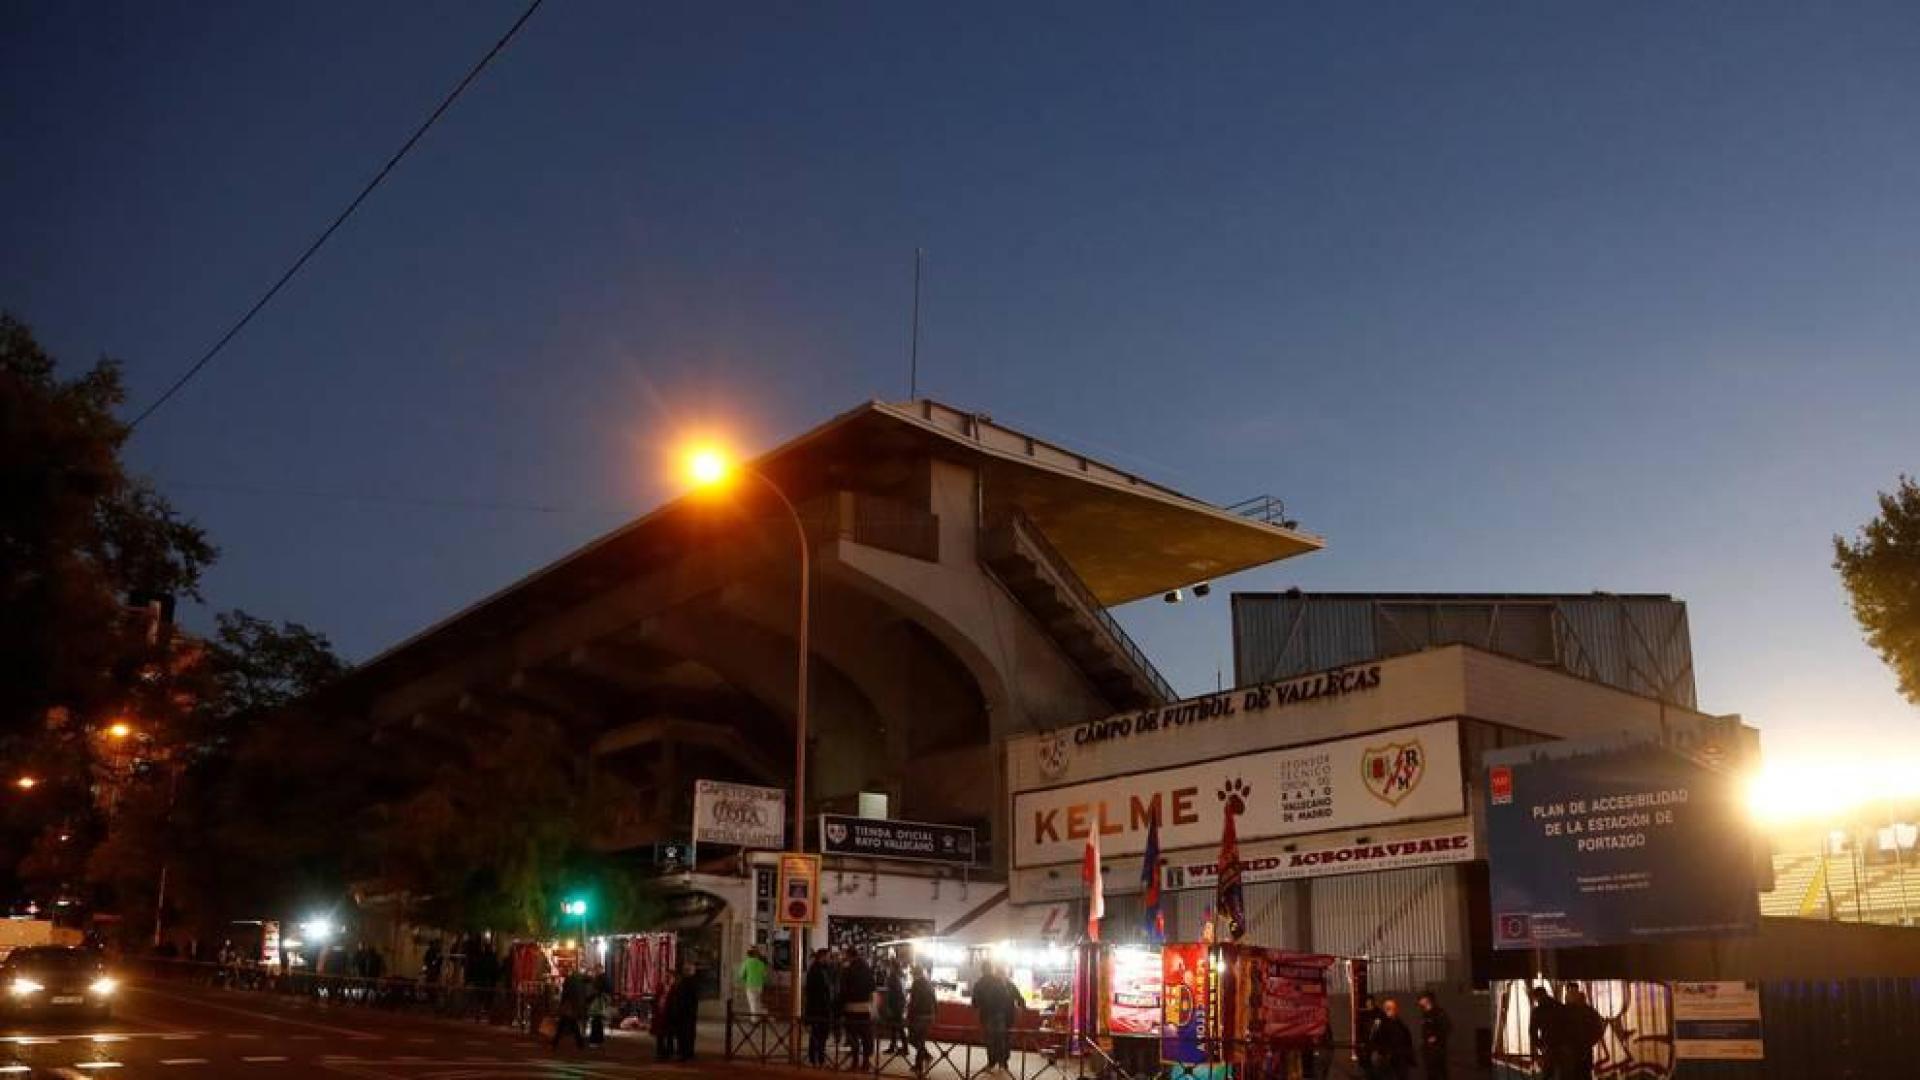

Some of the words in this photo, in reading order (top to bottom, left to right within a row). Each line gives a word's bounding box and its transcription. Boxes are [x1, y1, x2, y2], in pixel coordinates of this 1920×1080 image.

[1074, 717, 1132, 745] CAMPO
[1136, 710, 1159, 731] DE
[1244, 688, 1270, 711] DE
[1276, 666, 1381, 707] VALLECAS
[1282, 797, 1332, 810] VALLECANO
[1533, 804, 1564, 819] PLAN
[1569, 800, 1587, 816] DE
[1591, 789, 1689, 812] ACCESIBILIDAD
[1035, 787, 1199, 845] KELME
[1284, 812, 1294, 822] DE
[1299, 808, 1333, 819] MADRID
[1544, 822, 1562, 836] DE
[1566, 819, 1583, 834] LA
[1588, 811, 1650, 832] ESTACIÓN
[1656, 810, 1674, 824] DE
[855, 825, 892, 839] TIENDA
[896, 829, 934, 841] OFICIAL
[1578, 833, 1646, 852] PORTAZGO
[855, 837, 882, 848] RAYO
[884, 839, 935, 852] VALLECANO
[1187, 856, 1281, 878] WIRED
